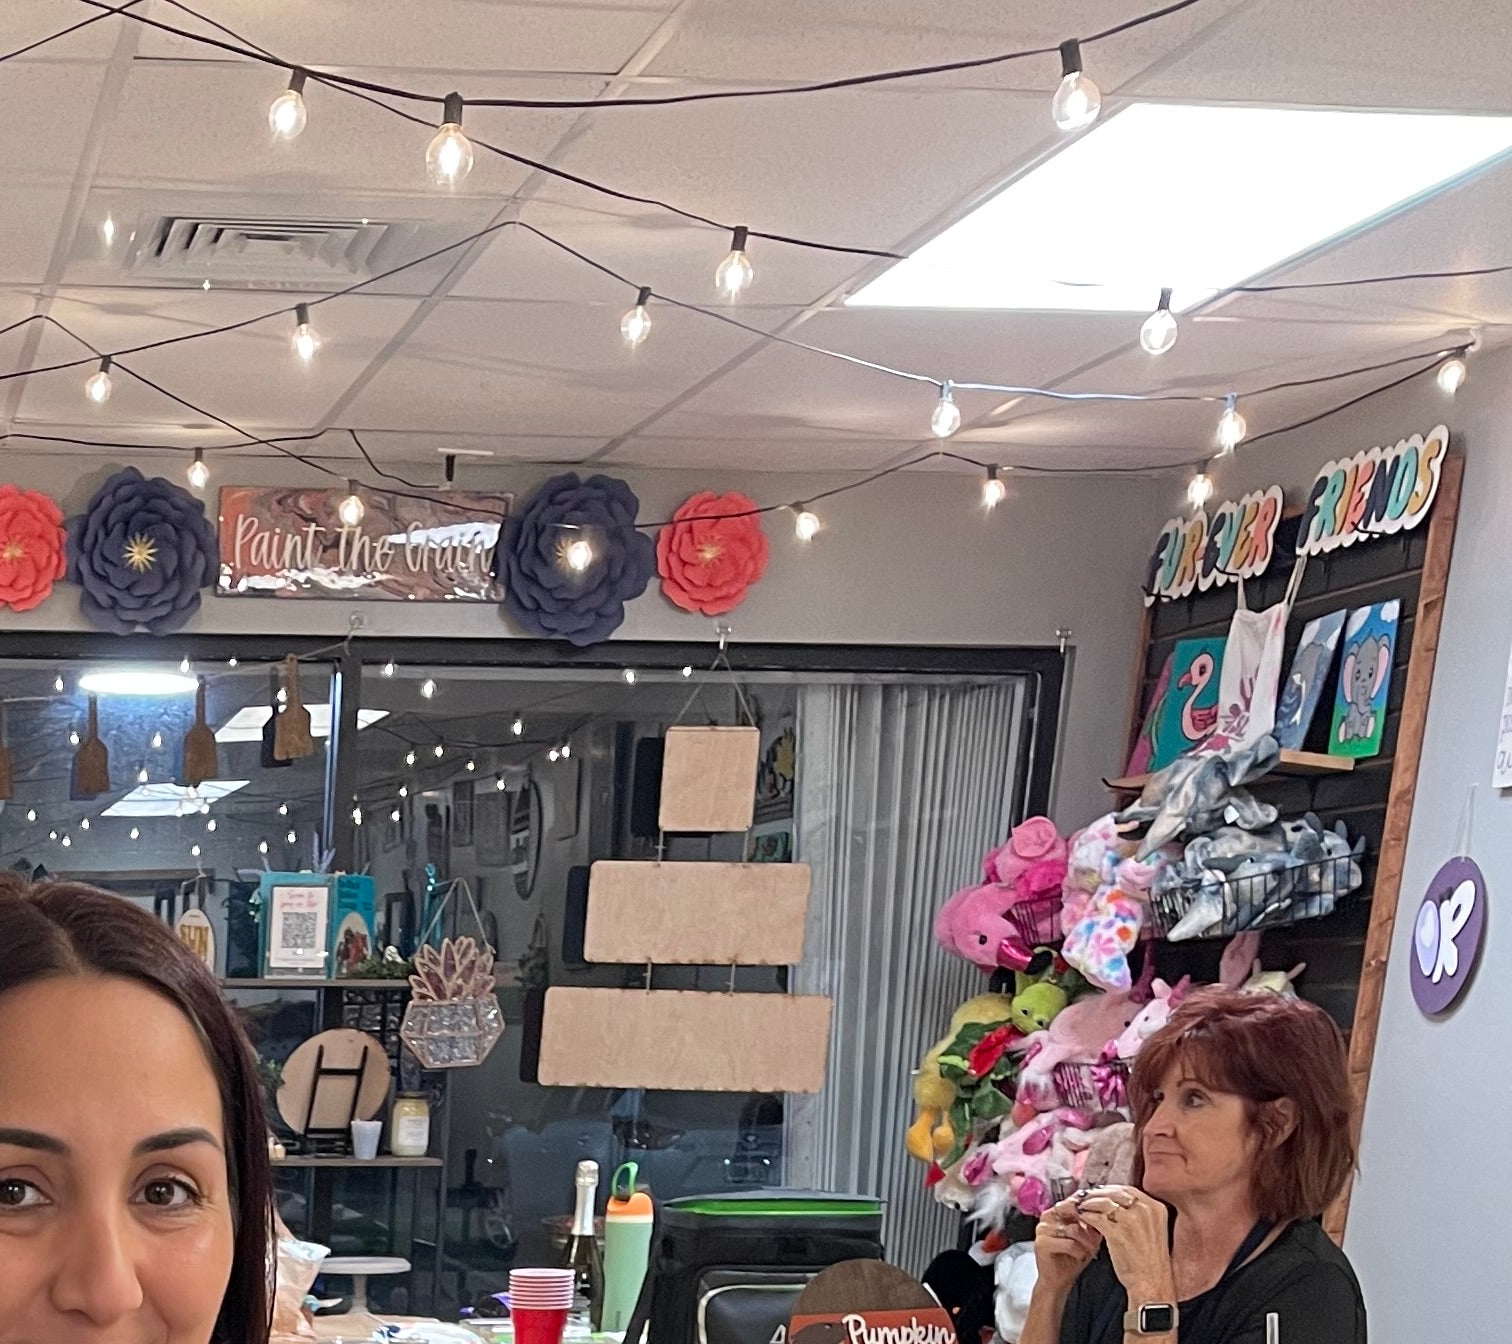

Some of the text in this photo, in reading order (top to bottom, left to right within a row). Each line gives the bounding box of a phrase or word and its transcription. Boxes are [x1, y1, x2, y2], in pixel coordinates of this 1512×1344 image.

[1297, 438, 1442, 548] FRIENDS
[234, 514, 326, 571] Paint
[335, 527, 395, 572] the
